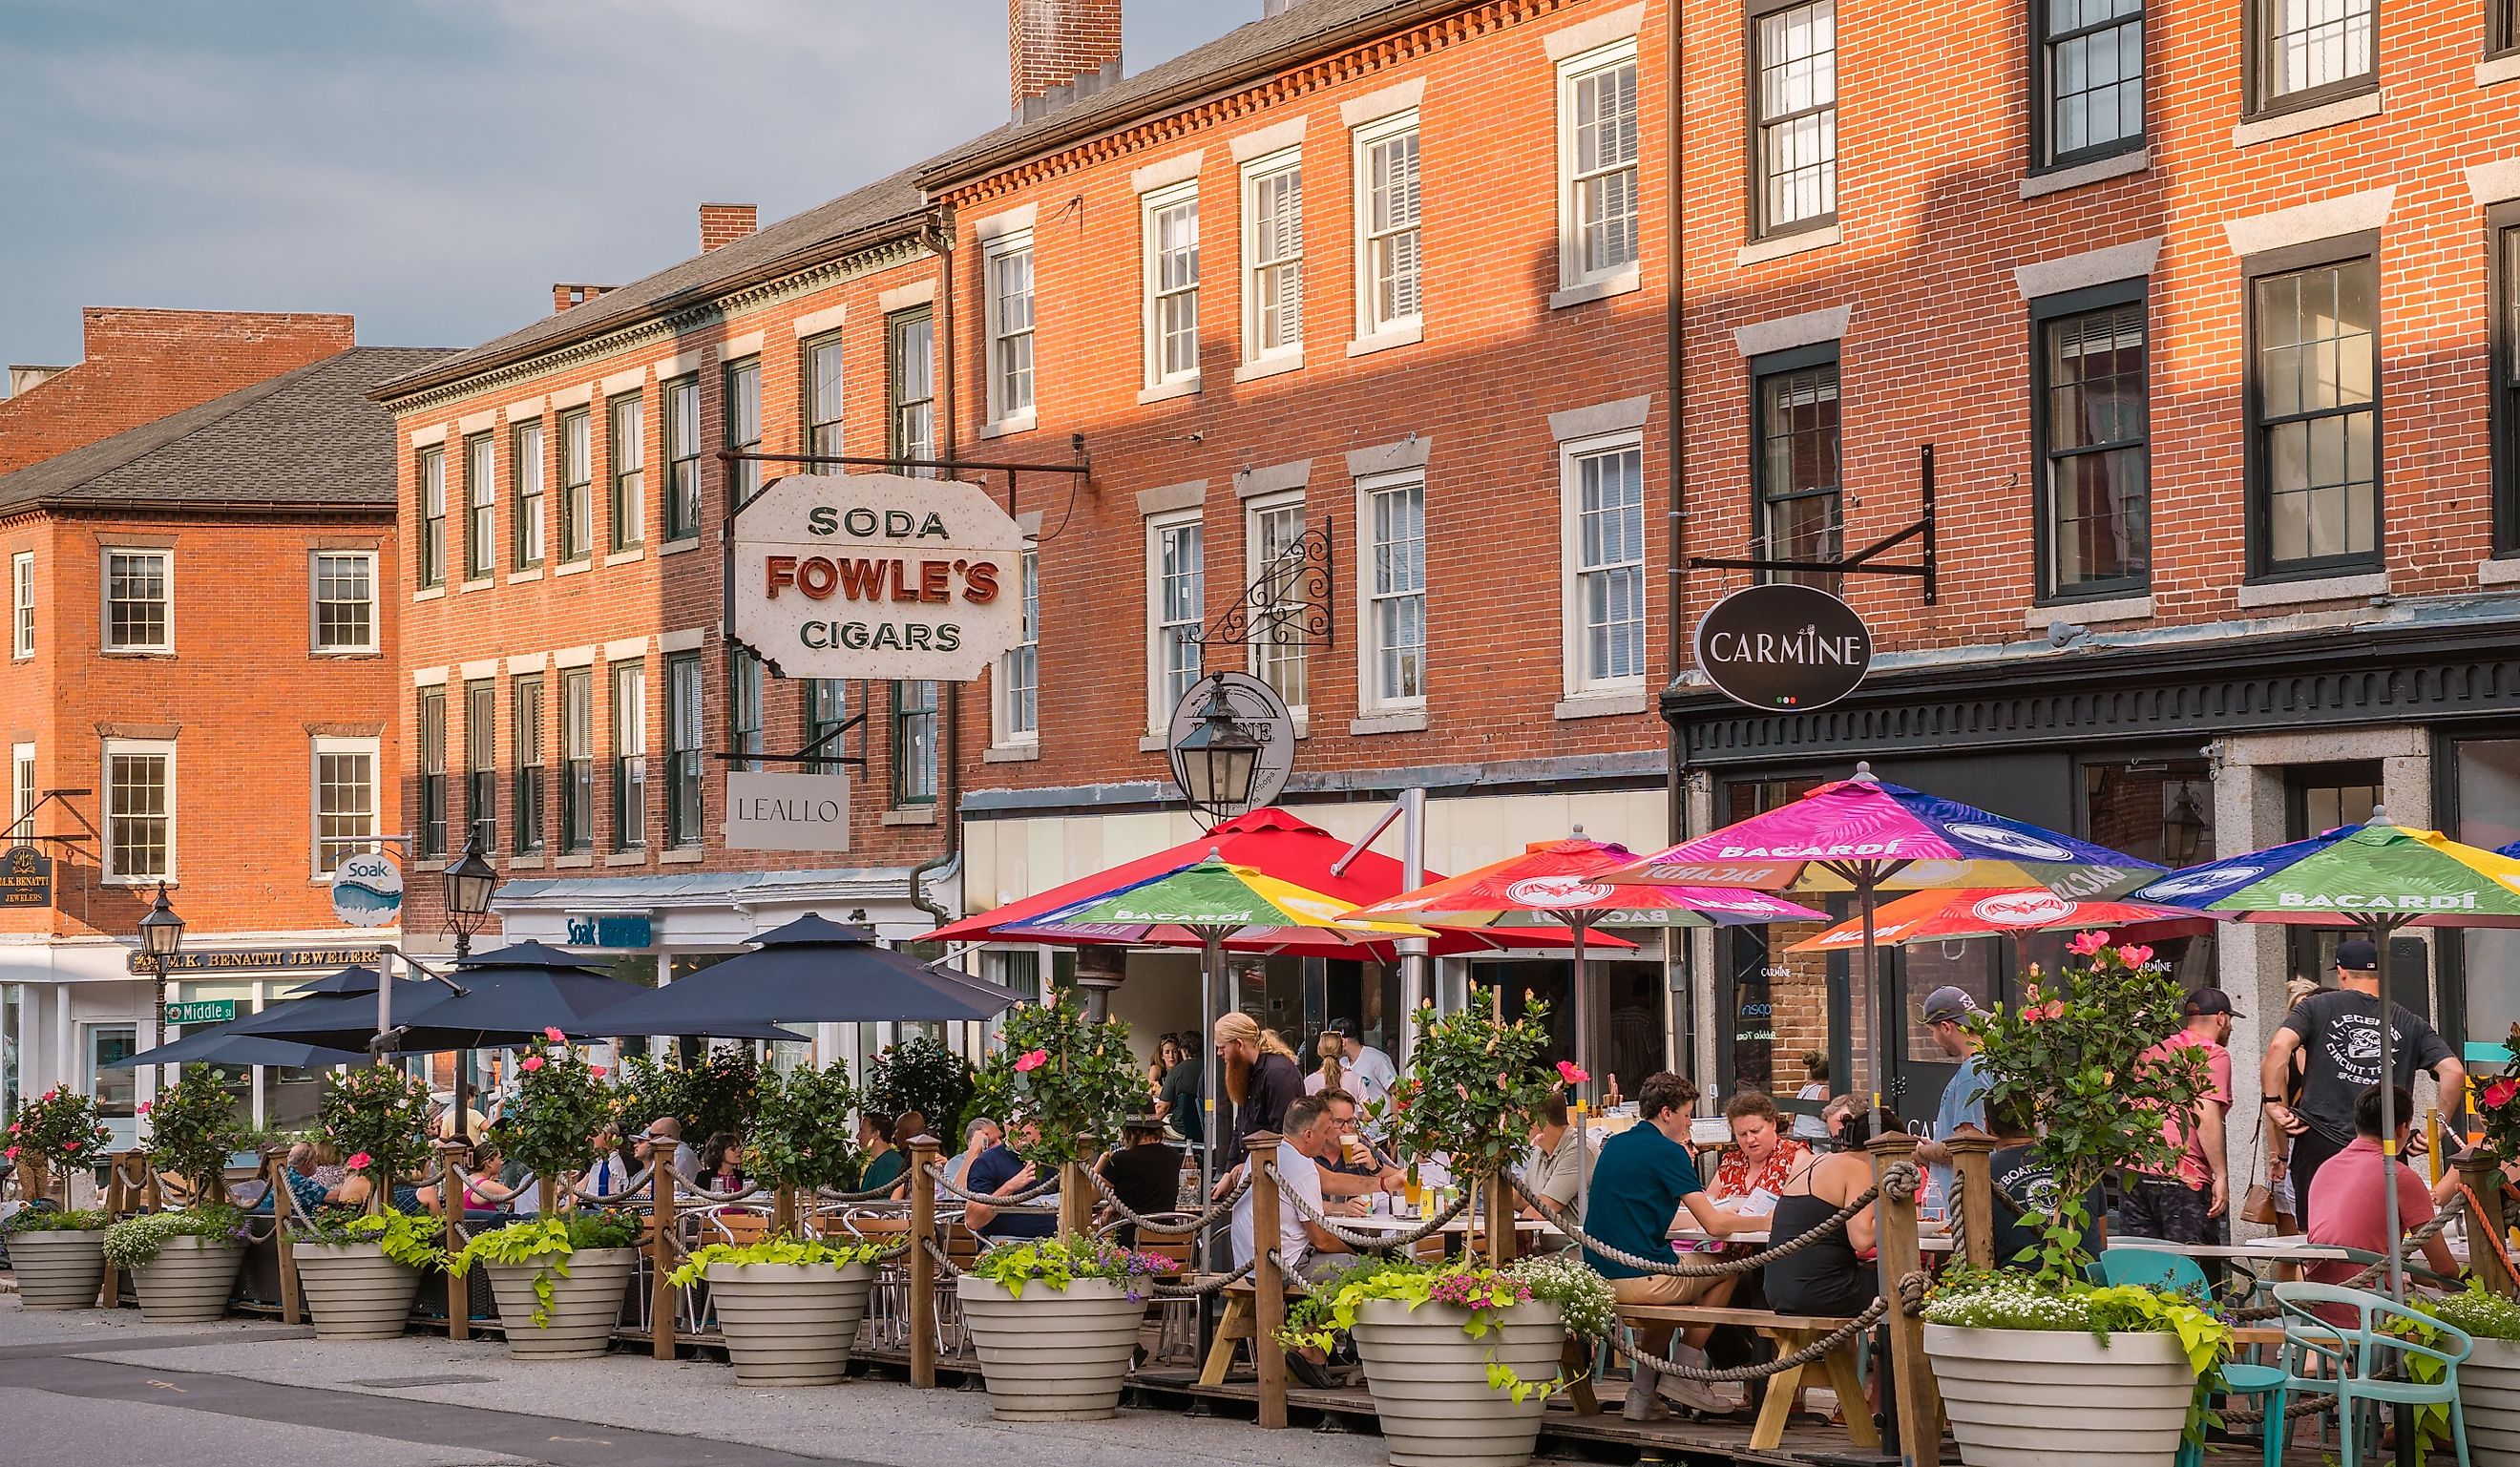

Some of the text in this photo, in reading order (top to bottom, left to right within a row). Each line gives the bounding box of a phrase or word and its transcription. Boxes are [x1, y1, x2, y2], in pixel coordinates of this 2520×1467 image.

[808, 507, 950, 539] SODA
[766, 555, 999, 604] FOWLE'S
[800, 620, 961, 652] CIGARS
[1710, 624, 1861, 666] CARMINE
[739, 798, 838, 823] LEALLO
[1717, 838, 1905, 858] BACARDÍ
[347, 861, 388, 877] Soak
[16, 876, 49, 887] BENATTI
[6, 893, 43, 902] JEWELERS
[2278, 891, 2475, 910] BACARDÍ
[1113, 909, 1253, 922] BACARDÍ
[567, 917, 597, 945] Soak
[167, 954, 201, 968] M.K.
[208, 953, 284, 966] BENATTI
[289, 951, 381, 964] JEWELERS
[2139, 958, 2173, 972] ARMINE
[1760, 965, 1792, 977] CARMINE
[183, 1004, 232, 1020] Middle St
[2325, 1042, 2365, 1075] CIRCUIT
